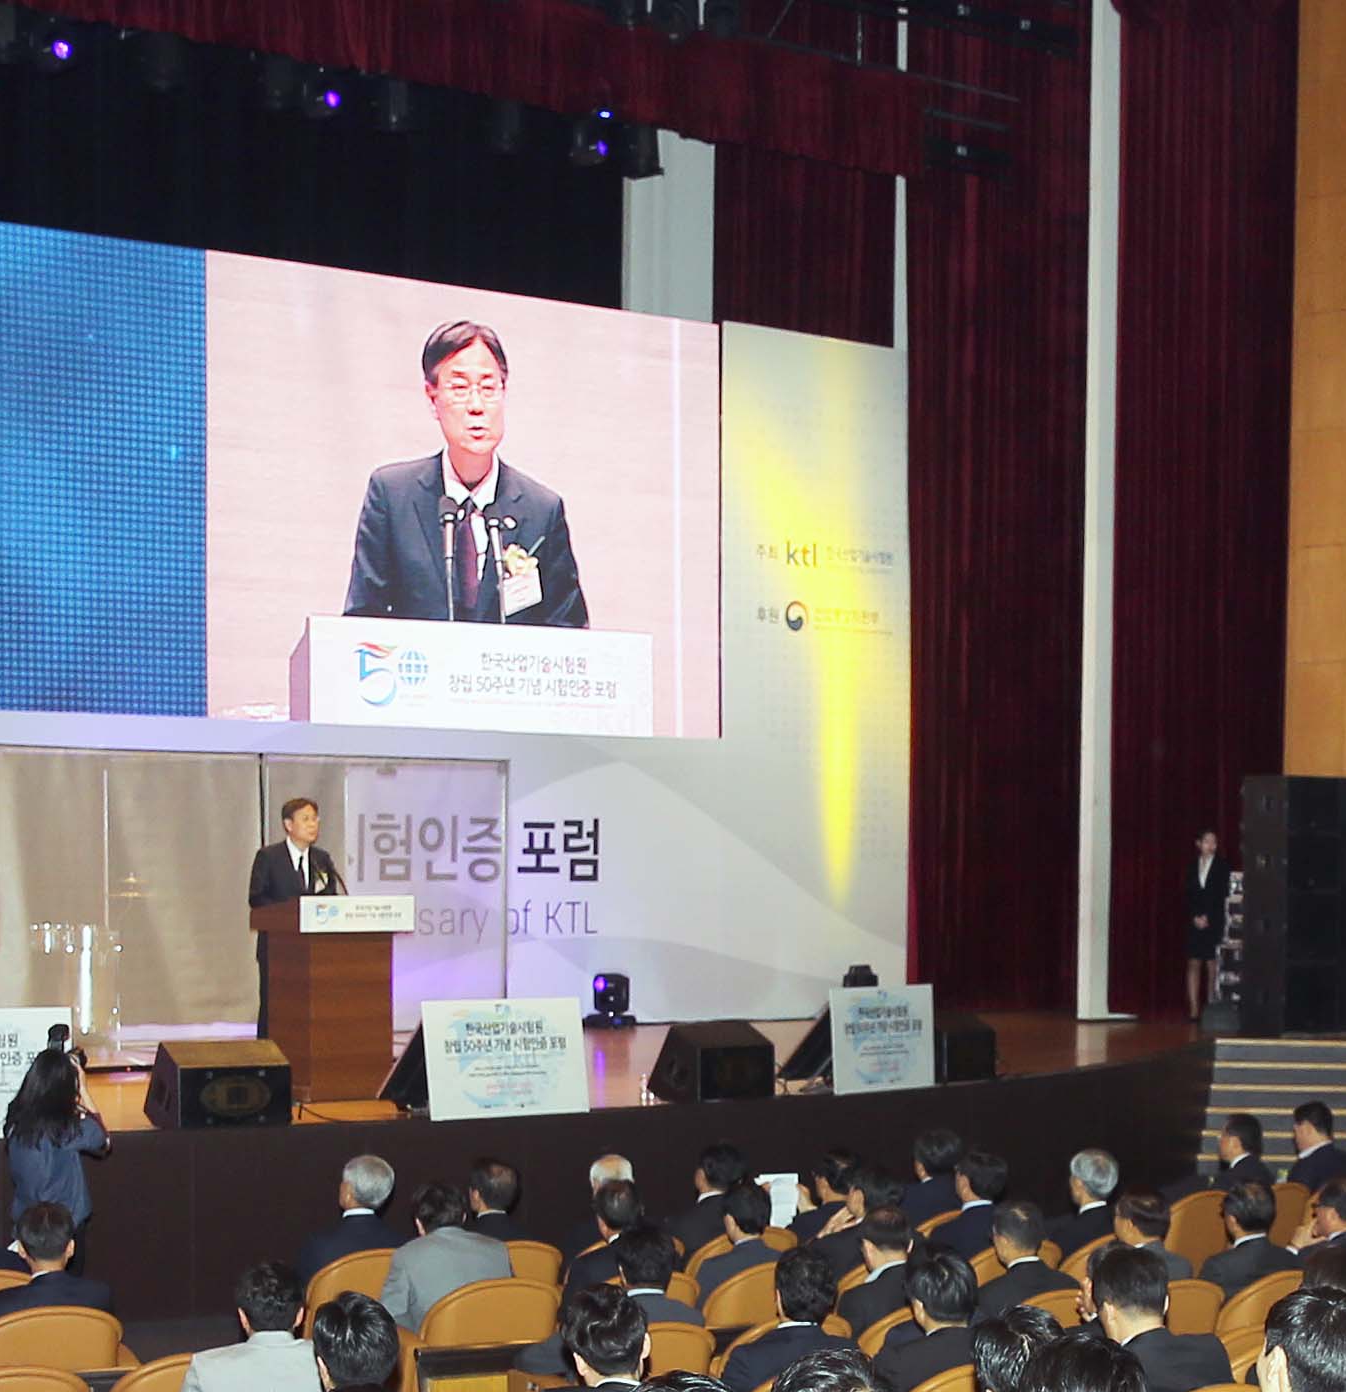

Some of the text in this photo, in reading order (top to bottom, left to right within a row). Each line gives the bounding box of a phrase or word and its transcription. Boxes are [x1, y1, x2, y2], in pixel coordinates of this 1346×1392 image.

[785, 540, 818, 569] ktl
[516, 818, 601, 883] 포럼
[507, 899, 533, 935] of
[544, 902, 598, 936] KTL
